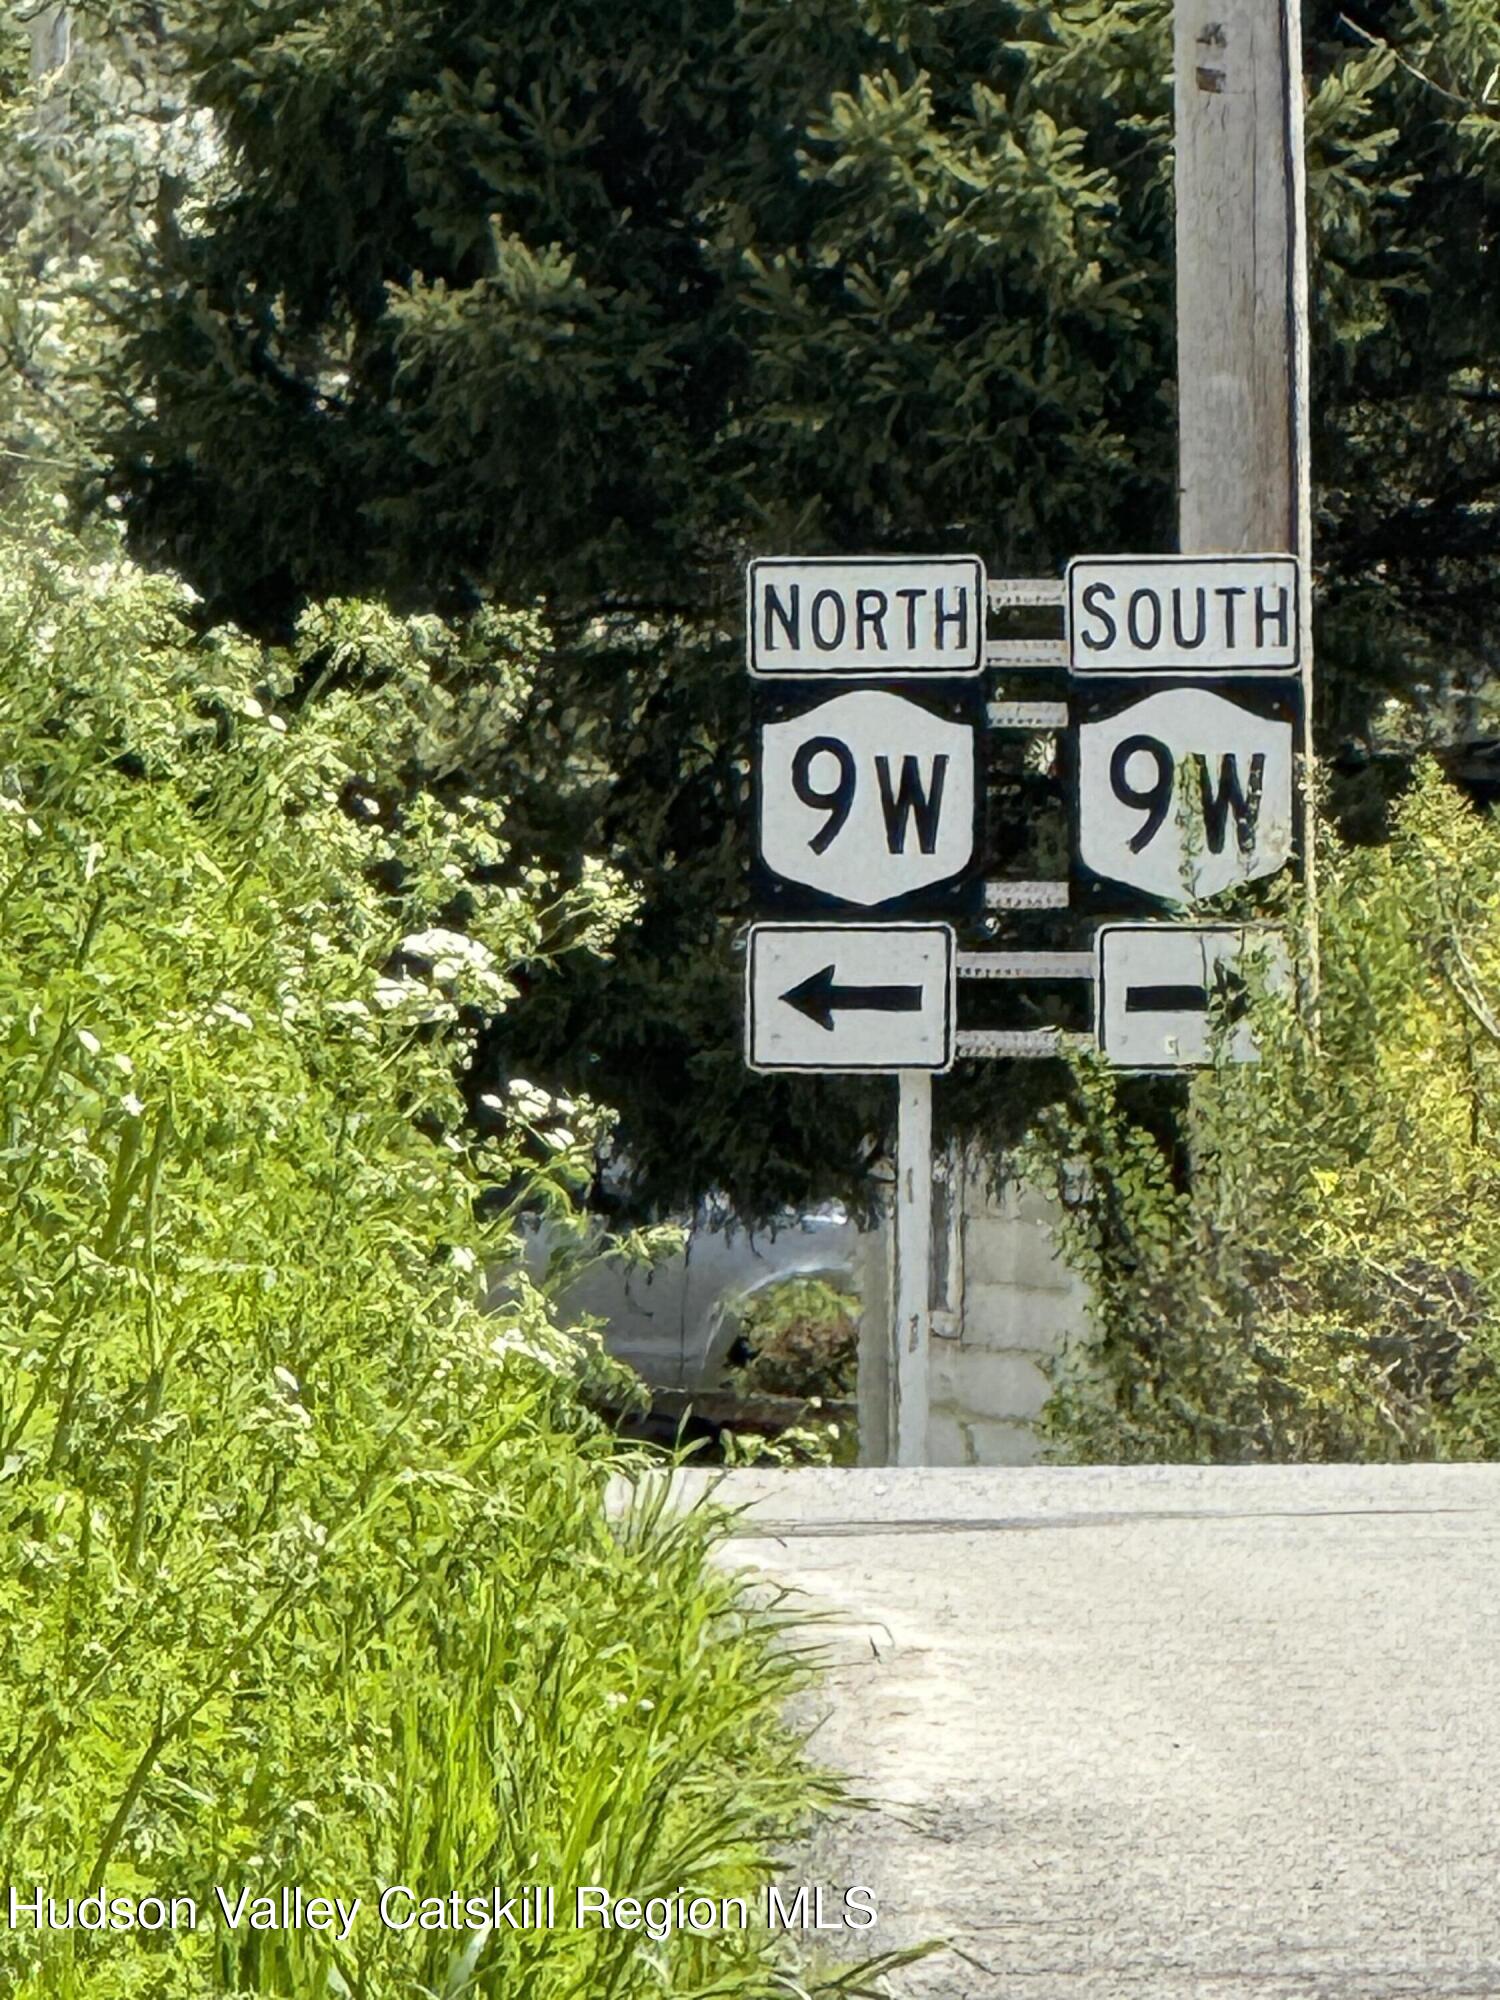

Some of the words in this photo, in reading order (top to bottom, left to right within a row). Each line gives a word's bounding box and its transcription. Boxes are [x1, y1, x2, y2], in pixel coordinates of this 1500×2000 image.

[764, 584, 968, 651] NORTH
[1081, 582, 1289, 650] SOUTH
[791, 735, 949, 855] 9W
[1109, 734, 1265, 855] 9W
